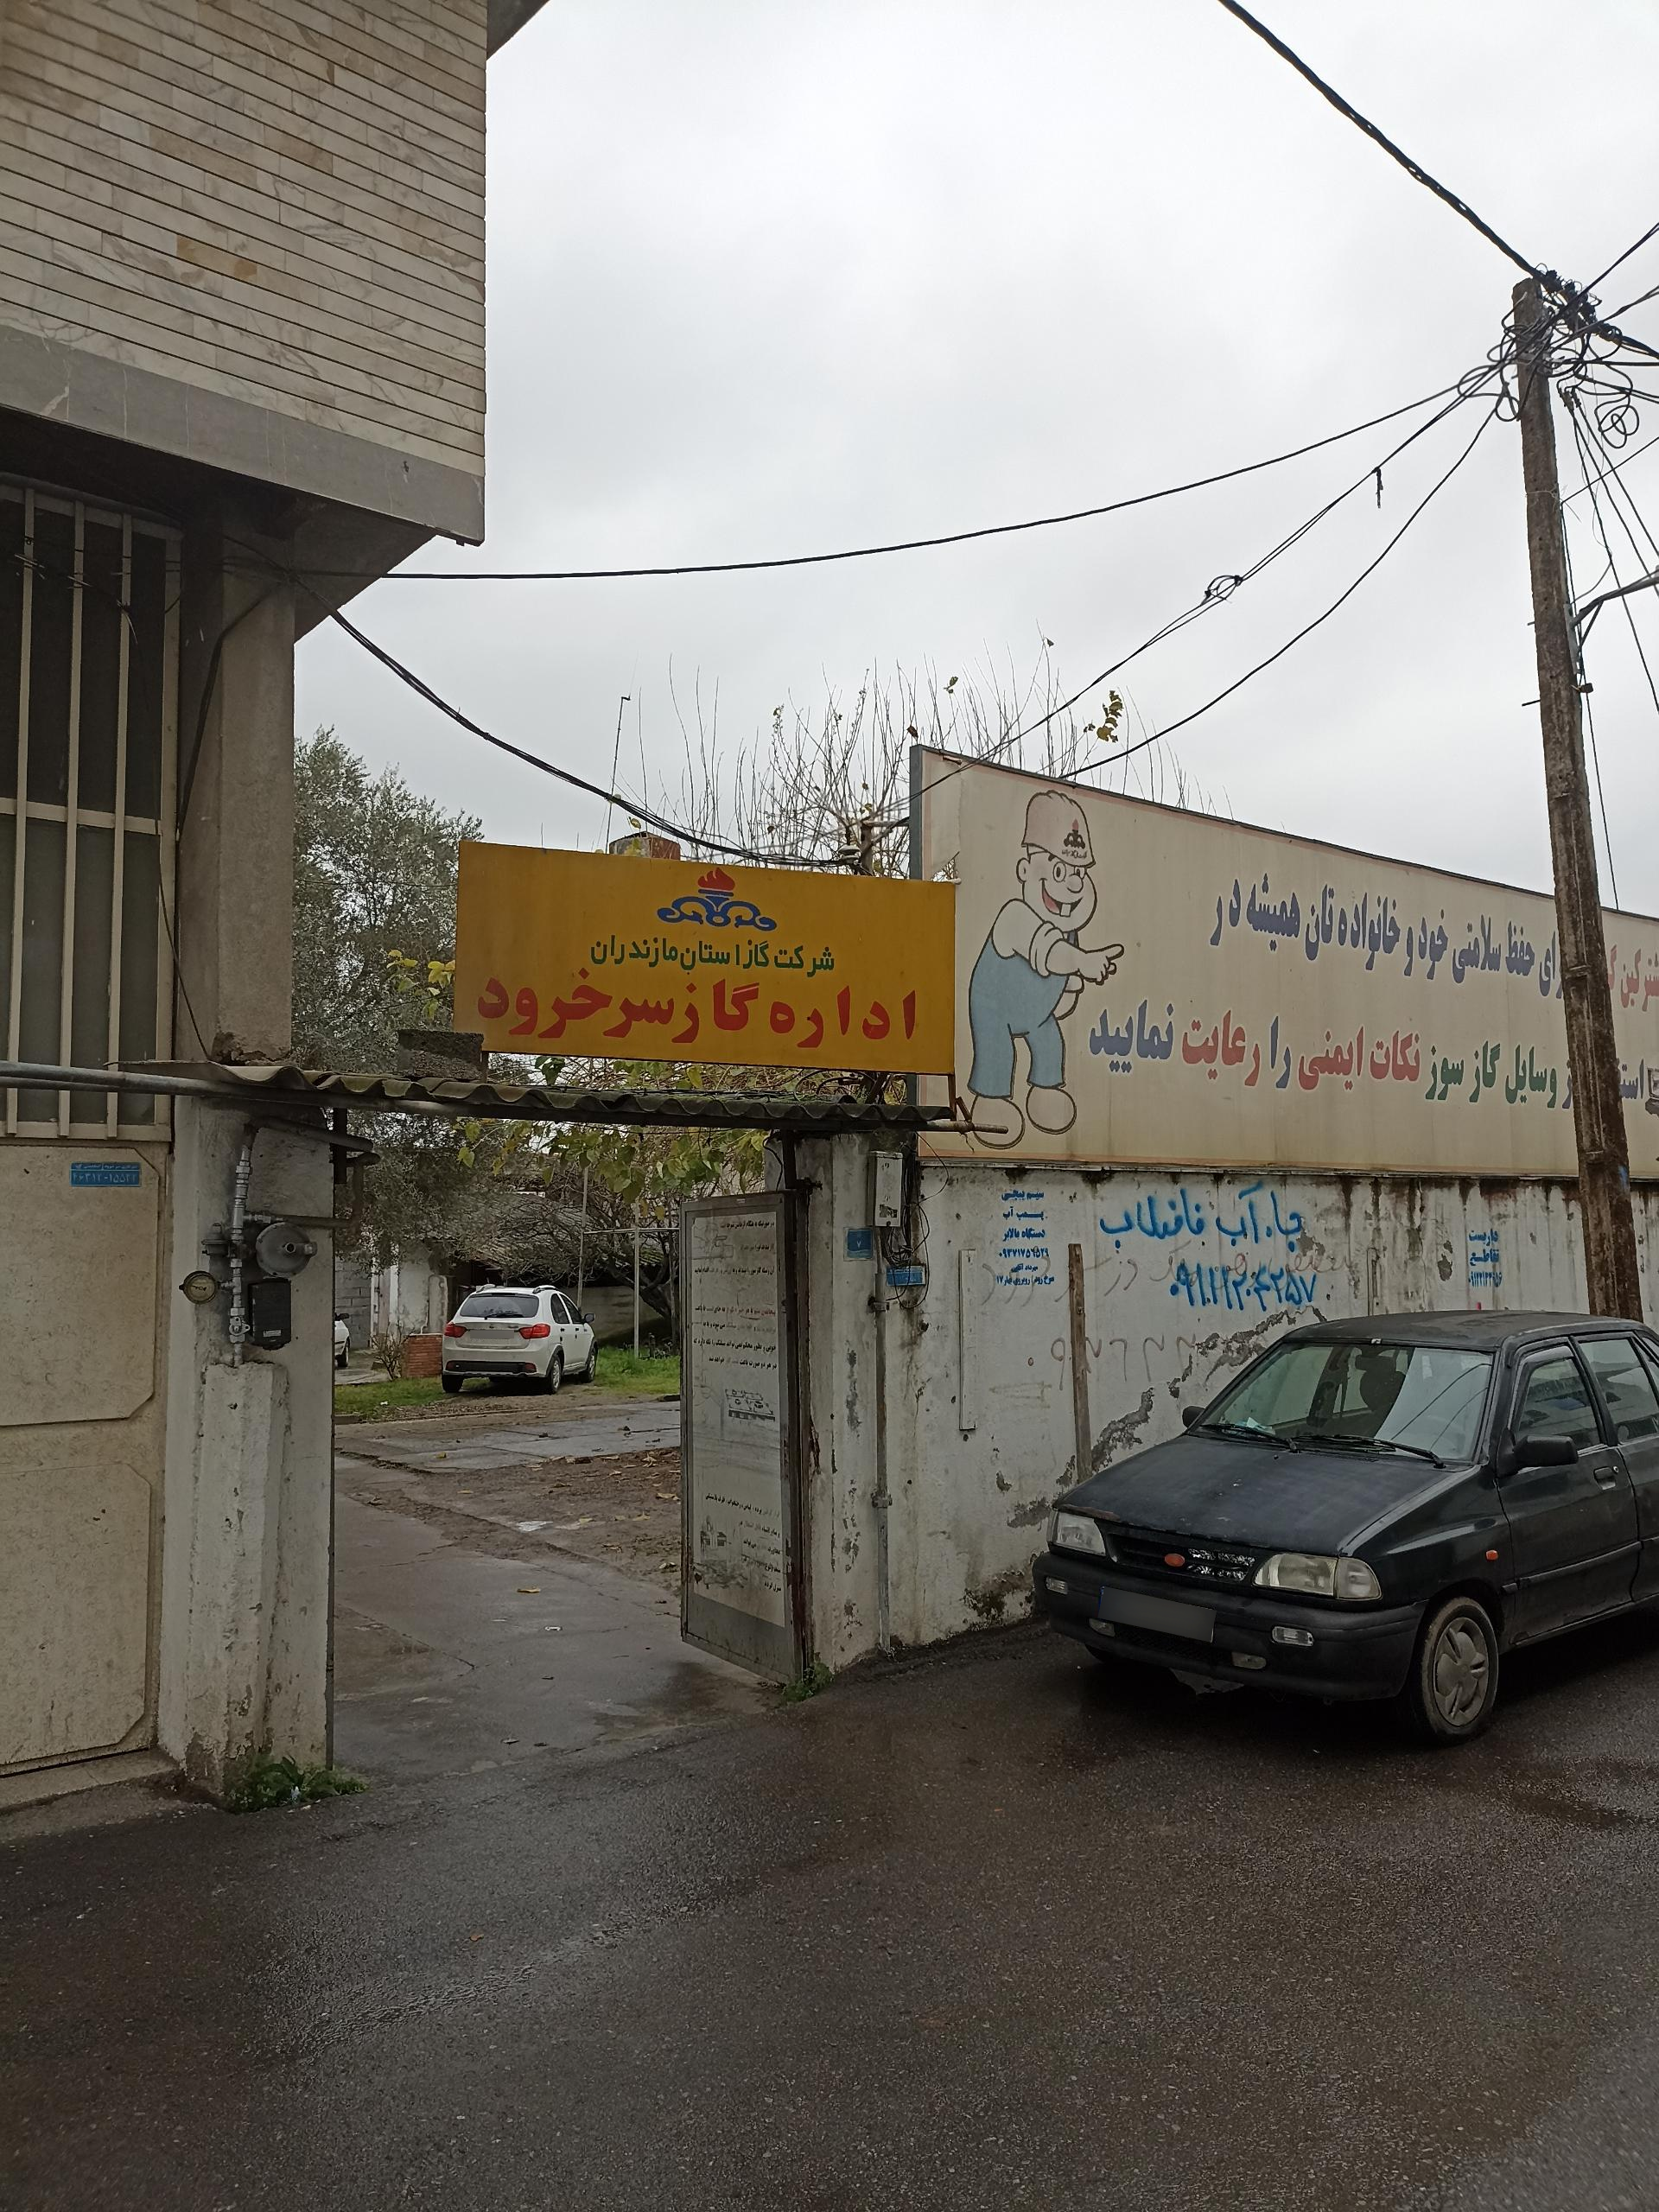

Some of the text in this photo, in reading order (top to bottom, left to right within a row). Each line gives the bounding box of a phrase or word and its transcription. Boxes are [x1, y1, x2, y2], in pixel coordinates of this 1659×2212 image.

[1210, 879, 1241, 946] در
[1247, 873, 1300, 951] همیشه
[590, 935, 836, 977] شرکت گاز استان مازندران
[1403, 926, 1414, 976] و
[1418, 909, 1448, 980] خود
[1452, 914, 1501, 983] سلامتی
[1506, 921, 1535, 976] حفظ
[477, 968, 916, 1048] اداره گاز سرخرود
[1620, 948, 1659, 1012] شترکین
[1089, 999, 1174, 1073] نمایید
[1181, 1010, 1261, 1087] رعایت
[1270, 1015, 1292, 1089] را
[1299, 1026, 1363, 1090] ایمنی
[1370, 1030, 1421, 1082] نکات
[1425, 1045, 1464, 1100] سوز
[1469, 1040, 1501, 1103] گاز
[1100, 1188, 1205, 1249] فاضلاب
